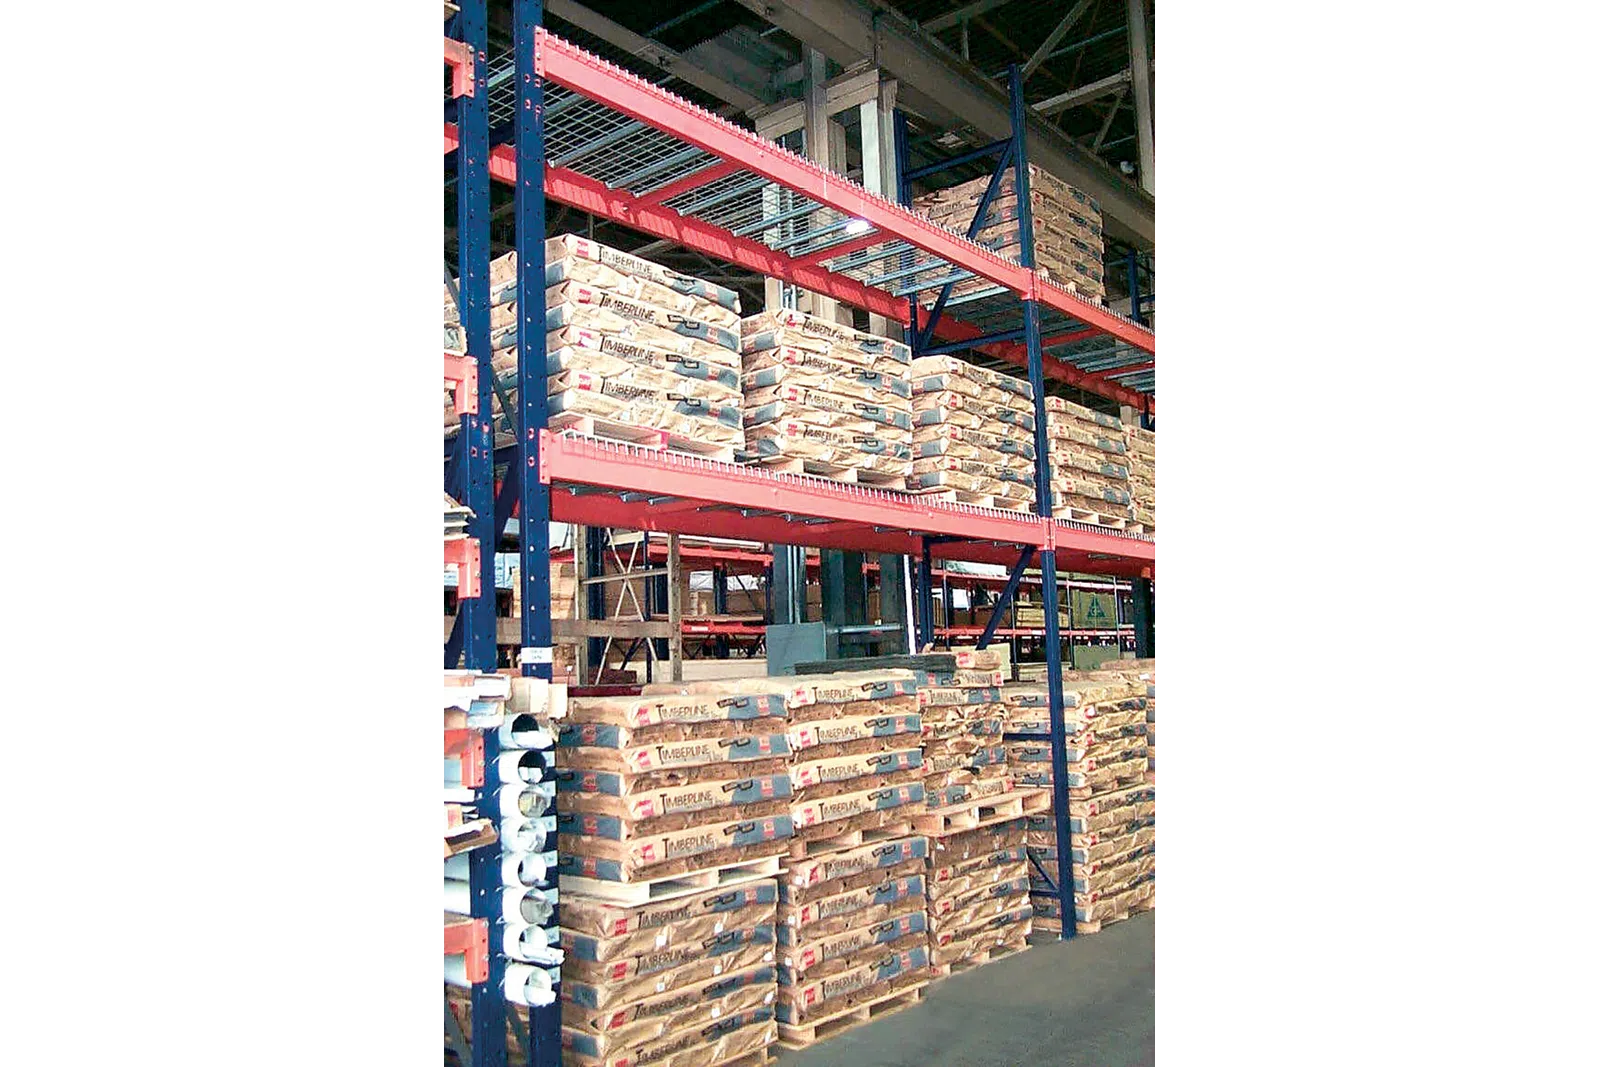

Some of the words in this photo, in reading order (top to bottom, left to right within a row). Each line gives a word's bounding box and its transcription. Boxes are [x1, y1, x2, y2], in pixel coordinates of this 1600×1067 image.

[597, 245, 653, 274] TIMBERLINE
[600, 292, 656, 320] TIMBERLINE
[599, 333, 655, 362] TIMBERLINE
[600, 376, 656, 399] TIMBERLINE
[656, 704, 709, 721] TIMBERLINE
[656, 745, 710, 764] TIMBERLINE
[660, 793, 713, 814] TIMBERLINE
[663, 834, 715, 858] TIMBERLINE
